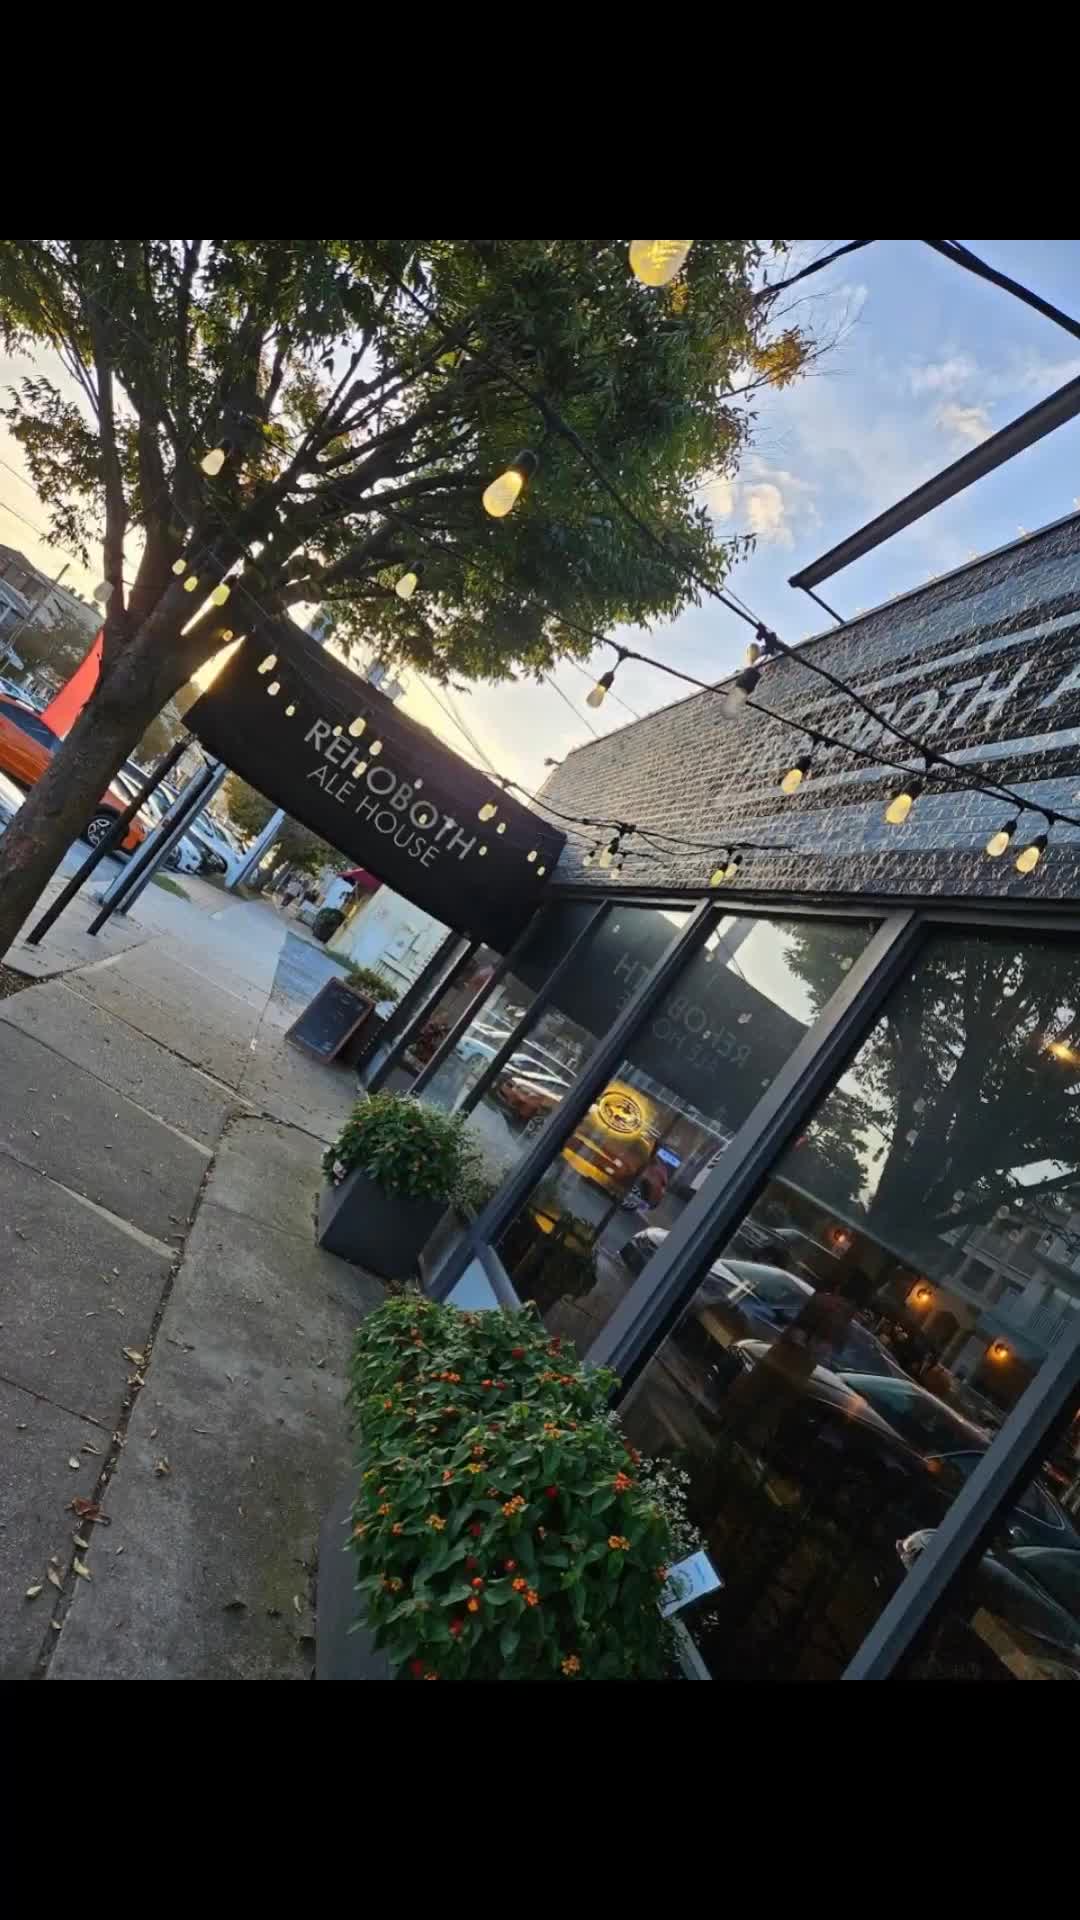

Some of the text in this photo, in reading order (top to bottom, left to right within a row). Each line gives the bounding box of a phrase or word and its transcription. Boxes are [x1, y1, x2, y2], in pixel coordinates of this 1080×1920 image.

[304, 718, 476, 859] REHOBOTH
[306, 764, 440, 868] ALE HOUSE
